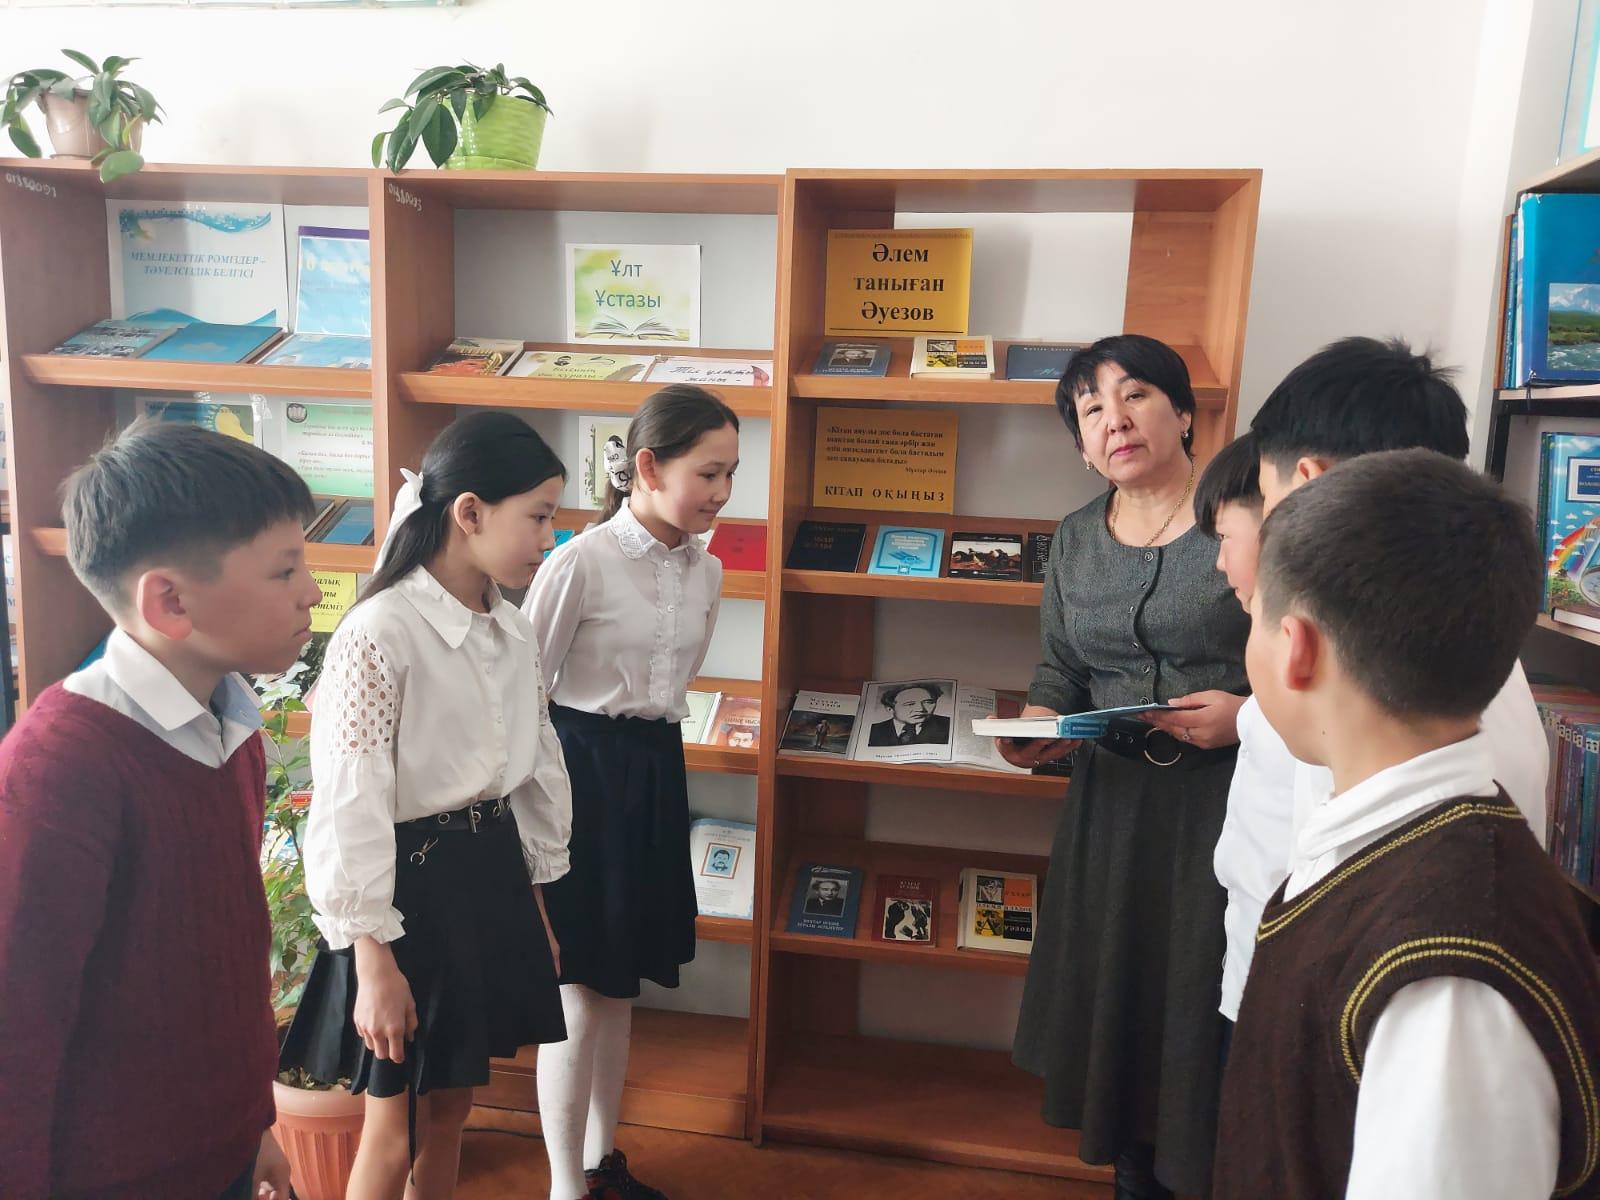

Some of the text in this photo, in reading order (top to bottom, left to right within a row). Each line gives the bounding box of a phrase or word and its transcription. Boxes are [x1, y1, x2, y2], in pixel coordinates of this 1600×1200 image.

[872, 243, 929, 262] Әлем
[610, 259, 643, 277] Ұлт
[854, 277, 945, 292] таныған
[595, 289, 661, 308] Ұстазы
[861, 301, 934, 325] Әуезов
[825, 485, 945, 502] КІТАП ОҚЫҢЫЗ
